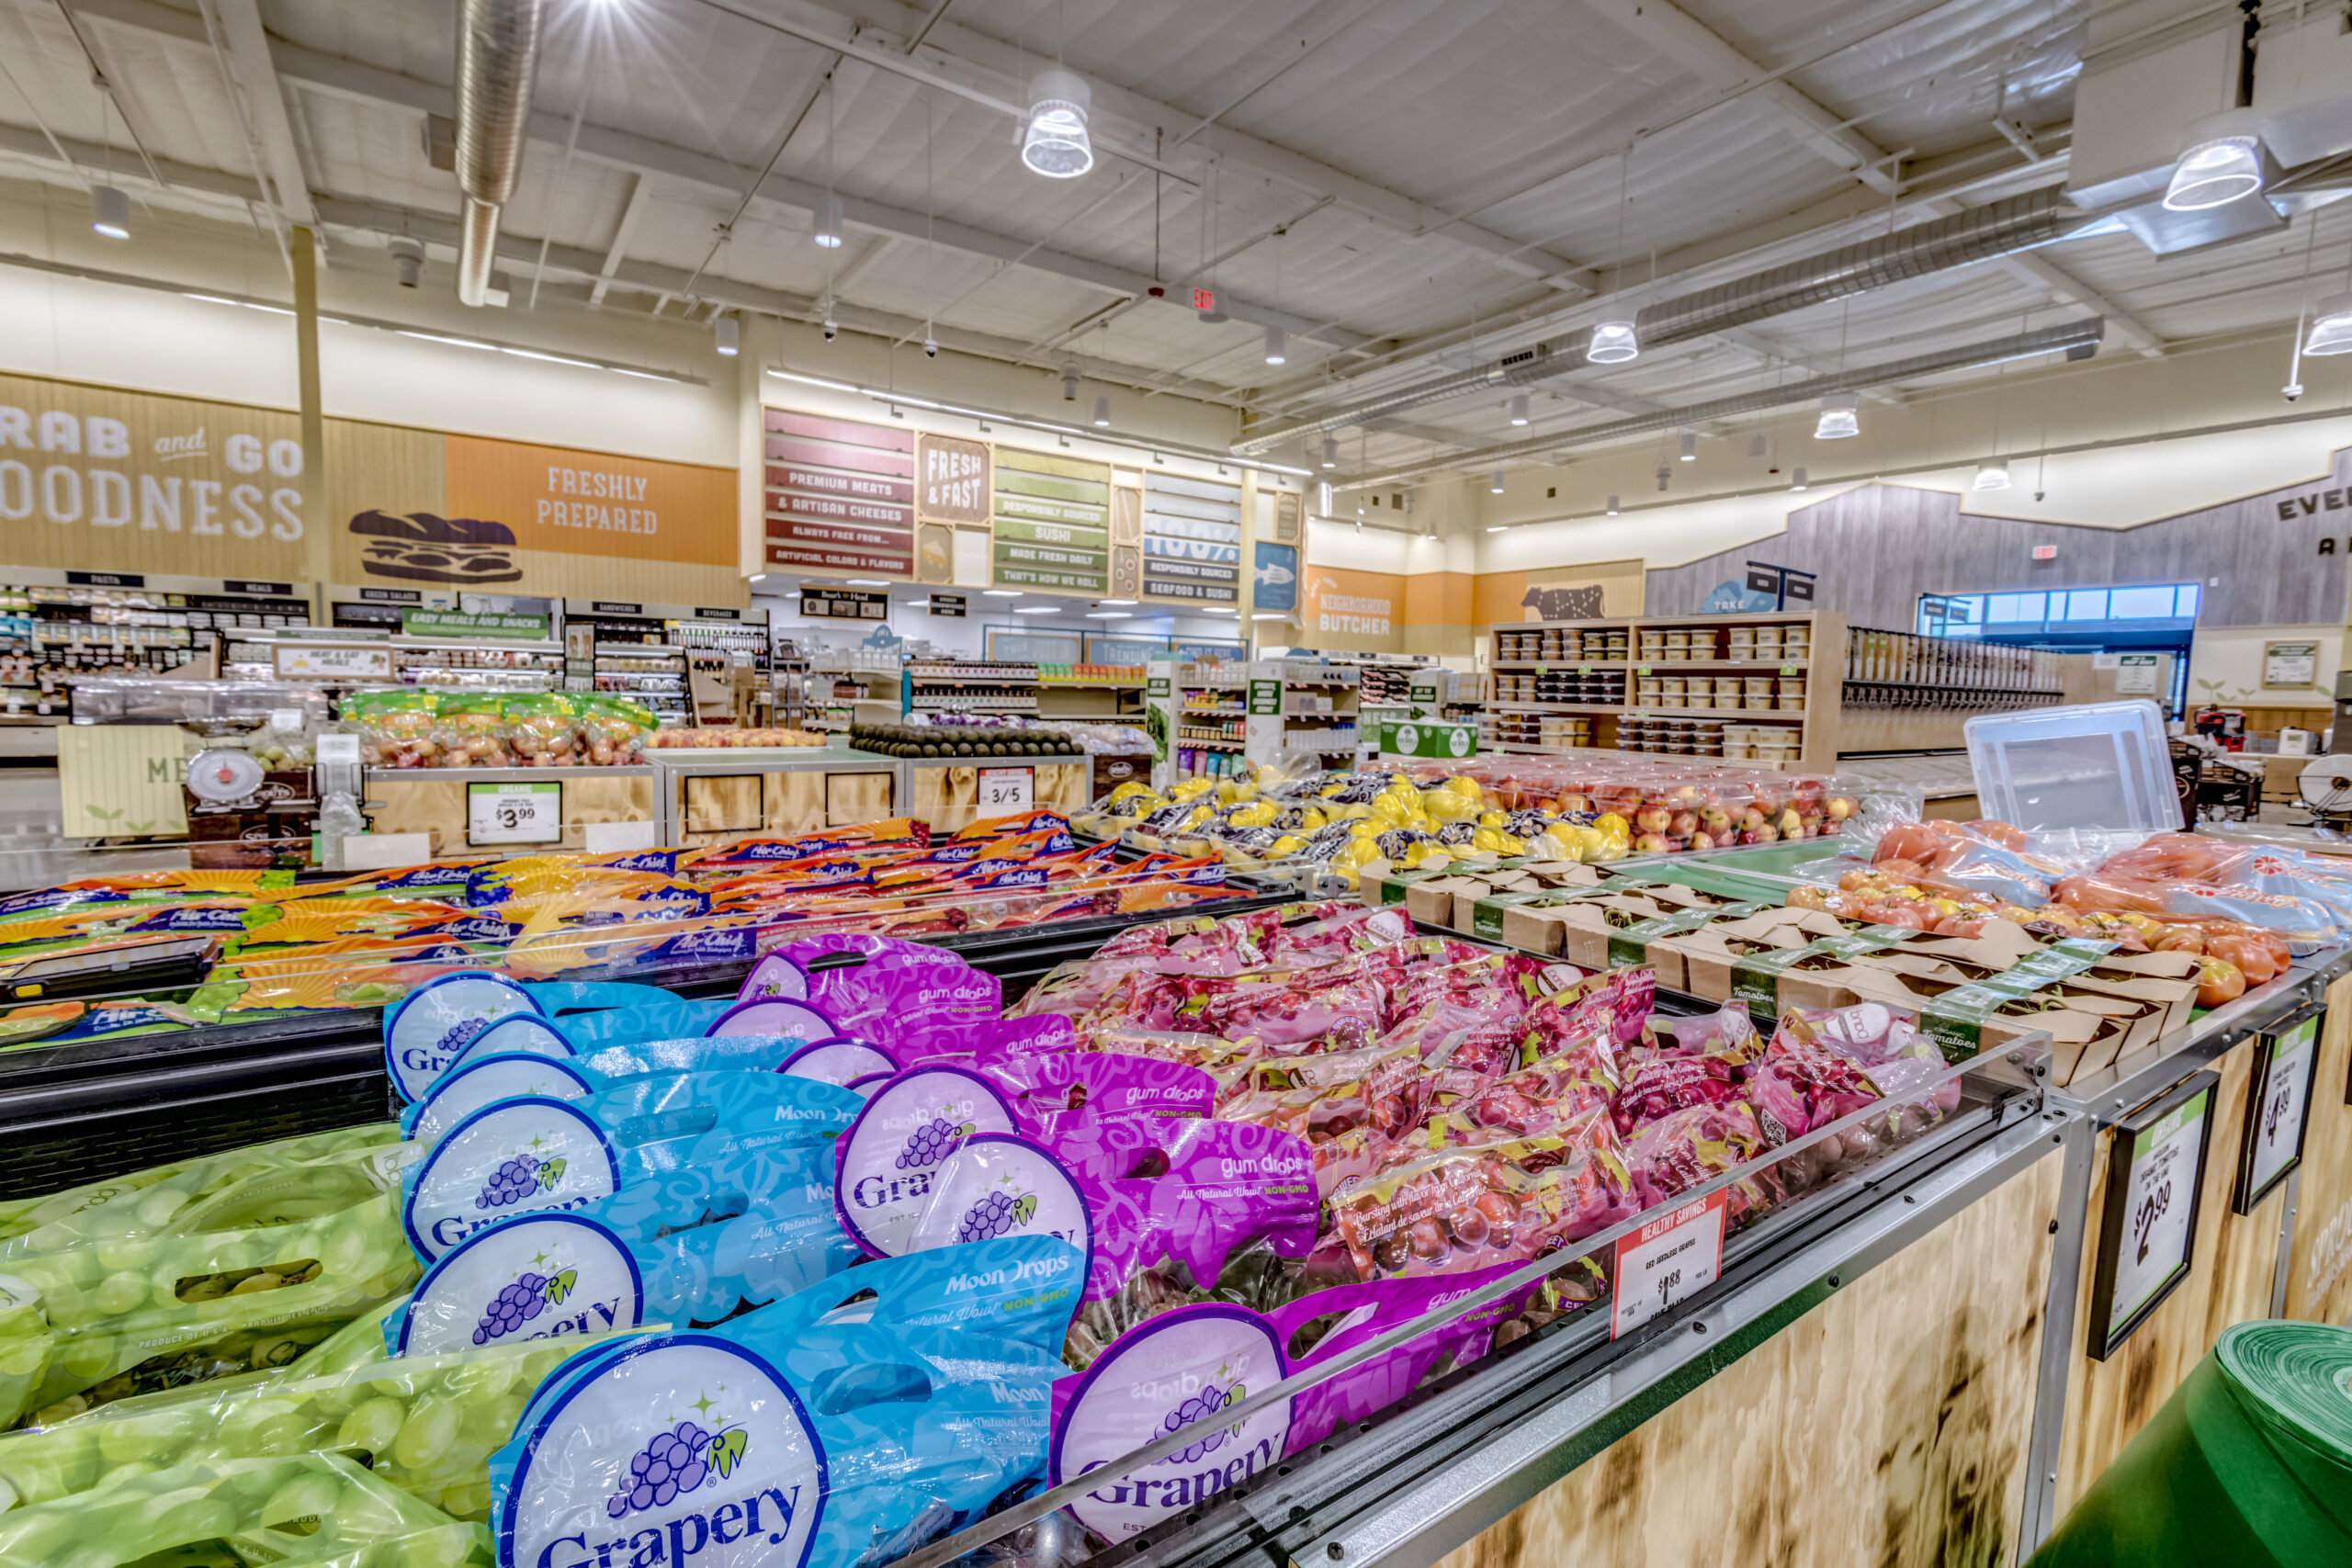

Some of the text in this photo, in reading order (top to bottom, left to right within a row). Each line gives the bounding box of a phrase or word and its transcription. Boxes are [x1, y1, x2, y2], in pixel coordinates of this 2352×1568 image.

[154, 427, 206, 457] and
[225, 434, 303, 477] GO
[927, 448, 981, 482] FRESH
[548, 467, 648, 502] FRESHLY
[789, 472, 893, 496] PREMIUM MEATS
[929, 479, 981, 509] & FAST
[793, 498, 845, 515] ARTISAN
[850, 503, 902, 522] CHEESES
[1003, 501, 1101, 523] RESPONSIBLY SOURCED
[2277, 486, 2352, 521] EVE
[537, 499, 658, 535] PREPARED
[793, 525, 829, 538] ALWAYS
[831, 530, 854, 541] FREE
[1035, 525, 1070, 543] SUSHI
[1148, 515, 1238, 561] 100%
[776, 549, 823, 563] ARTIFICIAL
[825, 554, 858, 567] COLORS
[868, 558, 904, 570] FLAVORS
[1011, 547, 1093, 566] MADE FRESH DAILY
[1004, 570, 1099, 588] THAT'S HOW WE ROLL
[1150, 562, 1233, 578] RESPONSIBLY SOURCED
[1150, 583, 1232, 600] SEAFOOD & SUSHI
[1713, 600, 1745, 610] TAKE
[411, 613, 541, 628] EASY MEALS AND SNACKS
[1319, 614, 1390, 635] BUTCHER
[670, 934, 706, 952] Air
[706, 931, 744, 953] Chief
[902, 953, 957, 965] gum drops
[919, 985, 992, 1003] gum drops
[1733, 987, 1775, 1003] Tomatoes
[951, 1005, 992, 1013] NON-GMO
[1006, 1028, 1067, 1053] gum drops
[1921, 1030, 1977, 1050] Tomatoes
[1933, 1025, 1966, 1037] ORGANIC
[1126, 1085, 1205, 1104] gum drops
[775, 1105, 826, 1121] Moon
[1155, 1110, 1203, 1118] NON-GMO
[719, 1142, 739, 1155] All
[740, 1134, 783, 1150] Natural
[1221, 1153, 1303, 1178] gum drops
[1176, 1184, 1309, 1200] All Natural Wow! NON-GMO
[1353, 1202, 1391, 1226] Bursting
[1391, 1196, 1409, 1212] with
[1408, 1186, 1430, 1207] flavor
[1448, 1167, 1483, 1188] California
[751, 1213, 824, 1240] All Natural
[1396, 1214, 1408, 1228] de
[1642, 1198, 1707, 1243] HEALTHY SAVINGS
[1645, 1237, 1696, 1270] RED SEEDLESS GRAPES
[944, 1269, 1005, 1295] Moon
[956, 1288, 1069, 1320] Wow! NON-GMO
[1427, 1287, 1470, 1312] gum
[241, 1312, 302, 1329] PRODUIT DES
[1464, 1302, 1516, 1322] NON-GMO
[139, 1331, 199, 1348] PRODUCE OF
[989, 1382, 1046, 1403] Moon
[955, 1416, 973, 1428] All
[973, 1416, 1019, 1428] Natural
